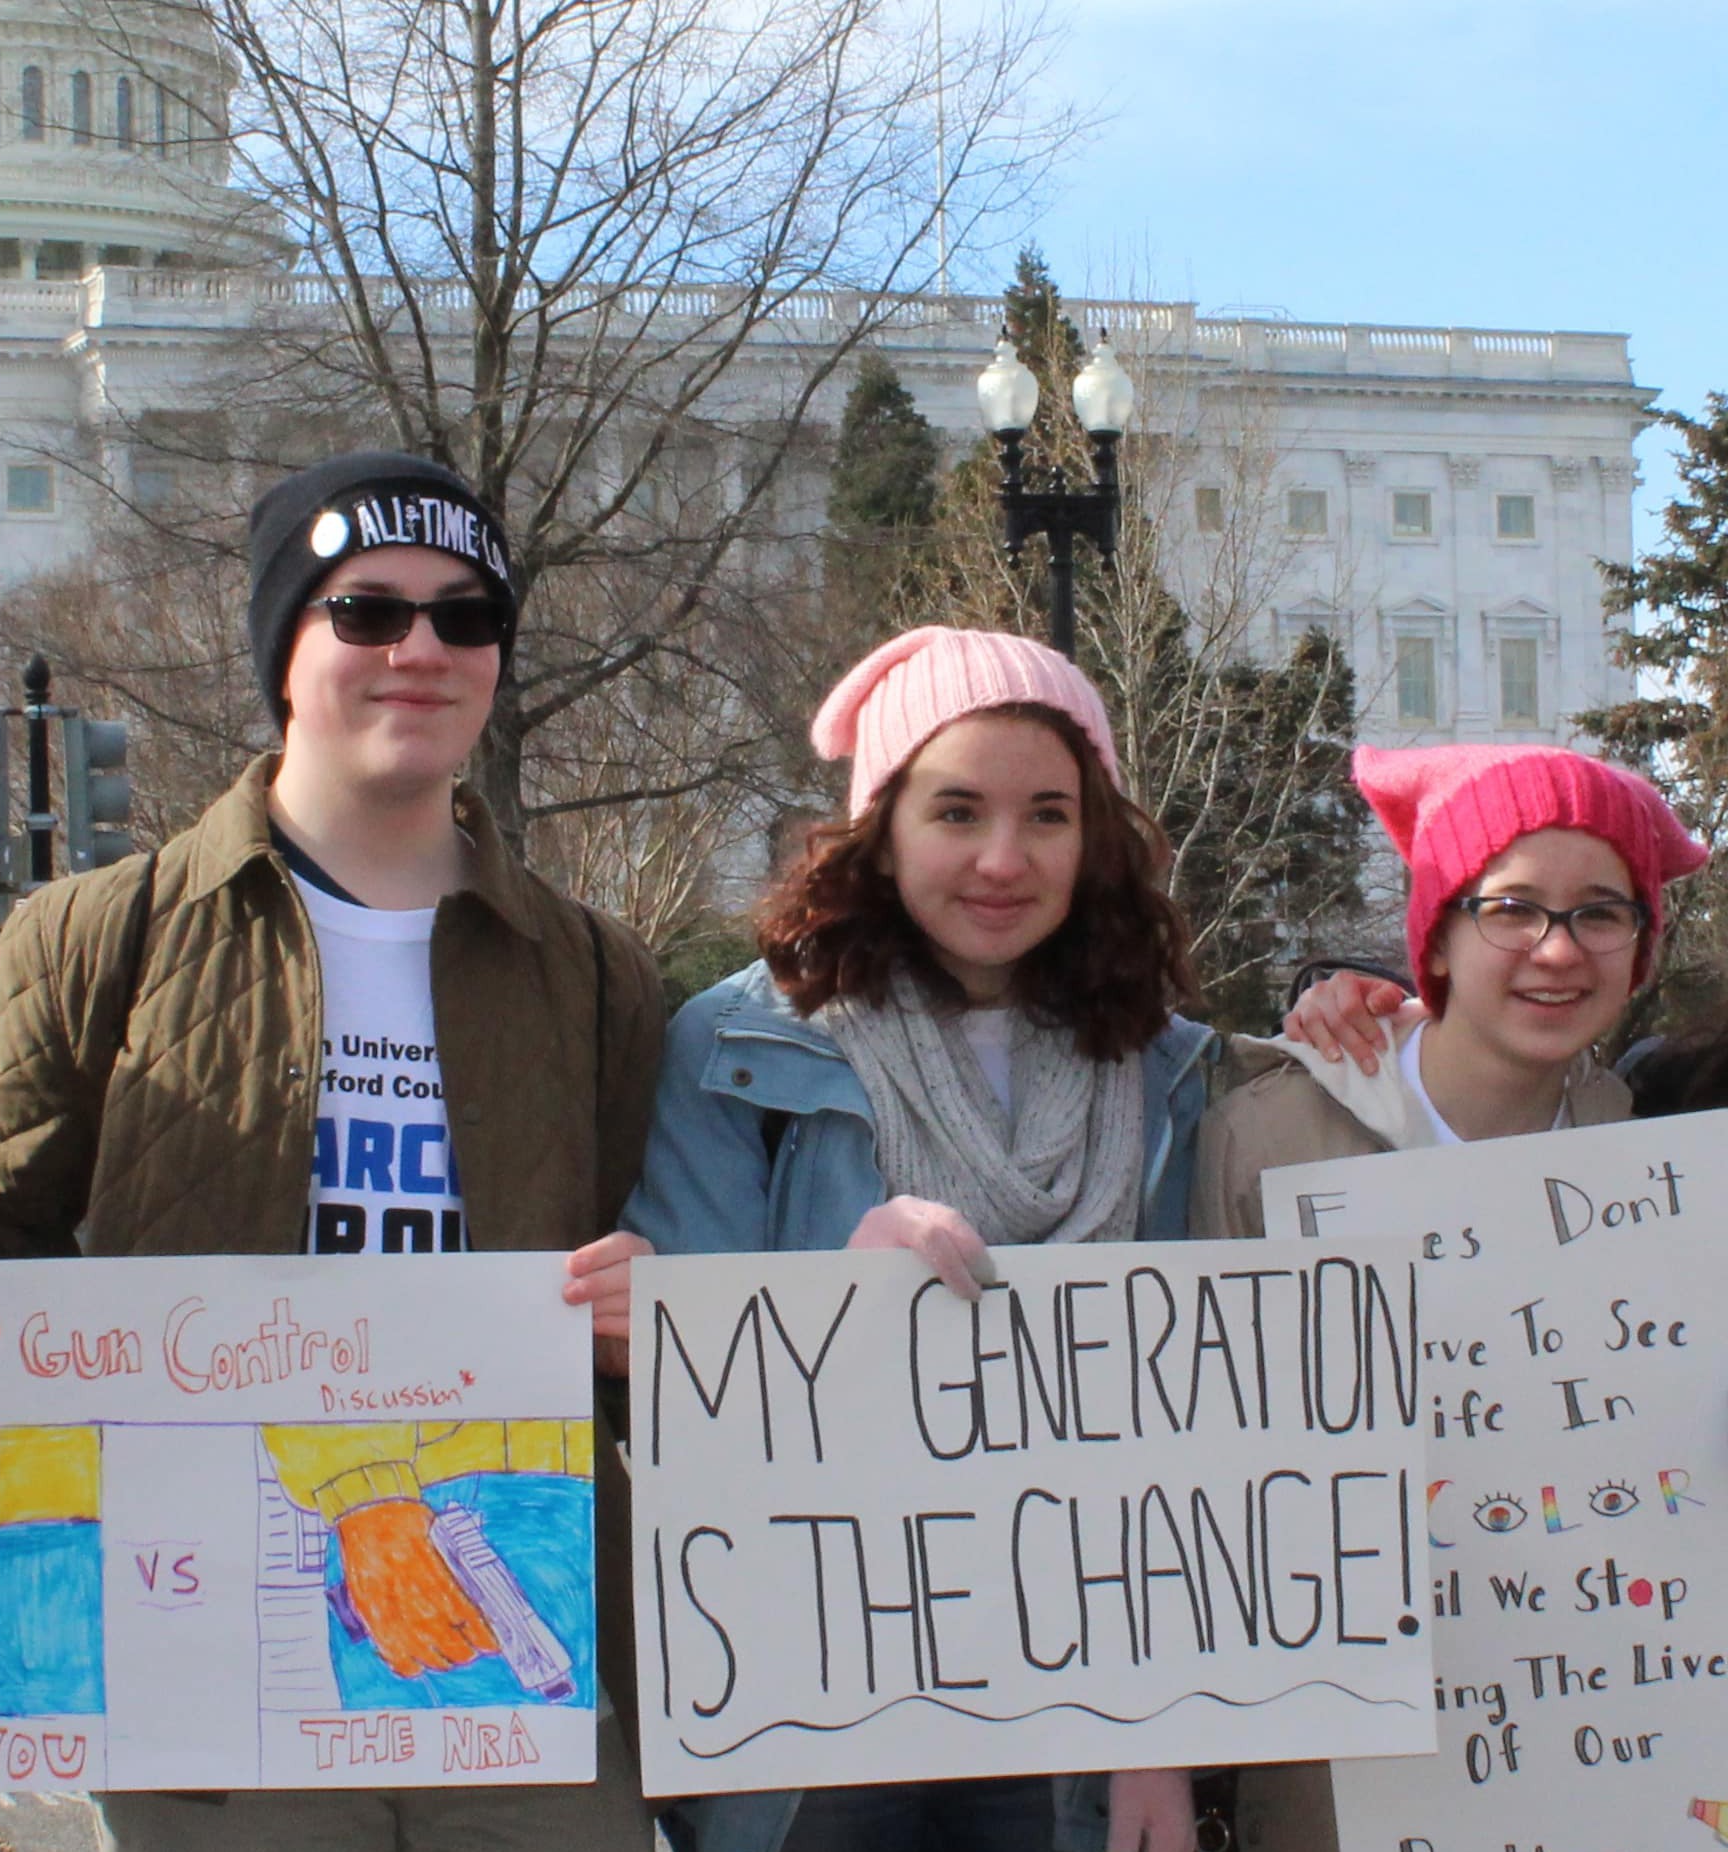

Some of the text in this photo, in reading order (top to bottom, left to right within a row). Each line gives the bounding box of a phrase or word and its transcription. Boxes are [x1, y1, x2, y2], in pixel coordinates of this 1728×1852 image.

[356, 497, 412, 548] ALL
[419, 497, 479, 560] TIME
[341, 1034, 436, 1062] Univer
[321, 1068, 445, 1100] ford Cou
[311, 1117, 463, 1198] ARC
[1543, 1161, 1685, 1246] Don't
[19, 1311, 143, 1380] Gun
[162, 1296, 371, 1395] Control
[1509, 1296, 1564, 1357] To
[1604, 1298, 1688, 1352] See
[651, 1256, 1418, 1467] MY GENERATION
[1428, 1376, 1636, 1439] ife In
[653, 1468, 1421, 1720] IS THE CHANGE!
[1488, 1570, 1547, 1613] We
[1575, 1557, 1688, 1622] Stop
[1513, 1653, 1608, 1700] The
[299, 1710, 541, 1774] THE NRA
[1465, 1721, 1665, 1785] Of Our
